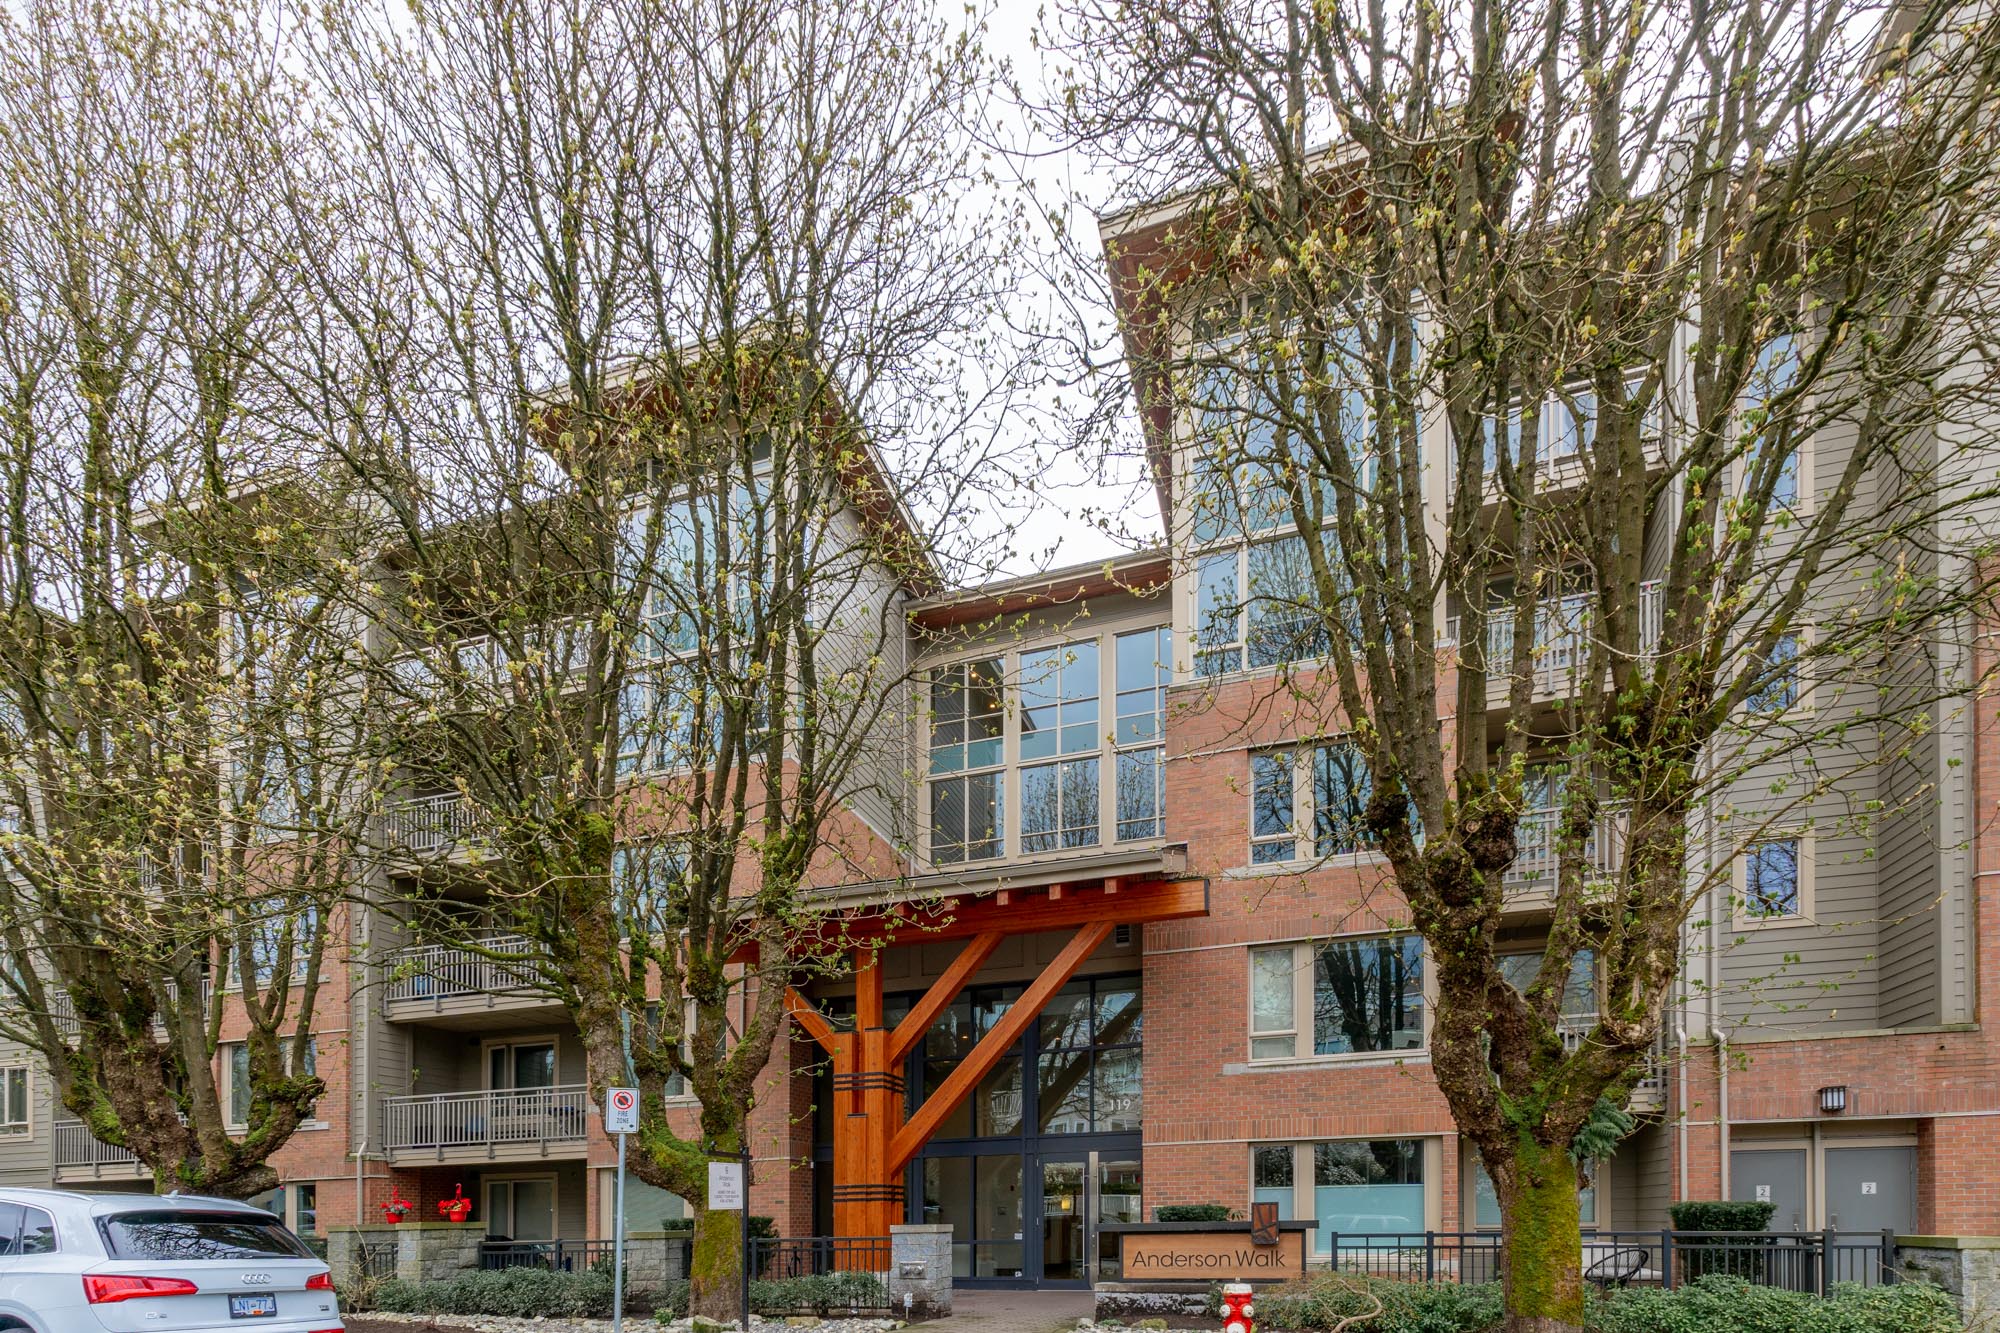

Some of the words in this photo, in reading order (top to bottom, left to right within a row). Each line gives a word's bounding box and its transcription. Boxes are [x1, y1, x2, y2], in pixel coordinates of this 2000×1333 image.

[1110, 1098, 1131, 1111] 119
[1760, 1188, 1766, 1196] 2
[1132, 1250, 1231, 1268] Anderson
[1235, 1250, 1286, 1268] Walk
